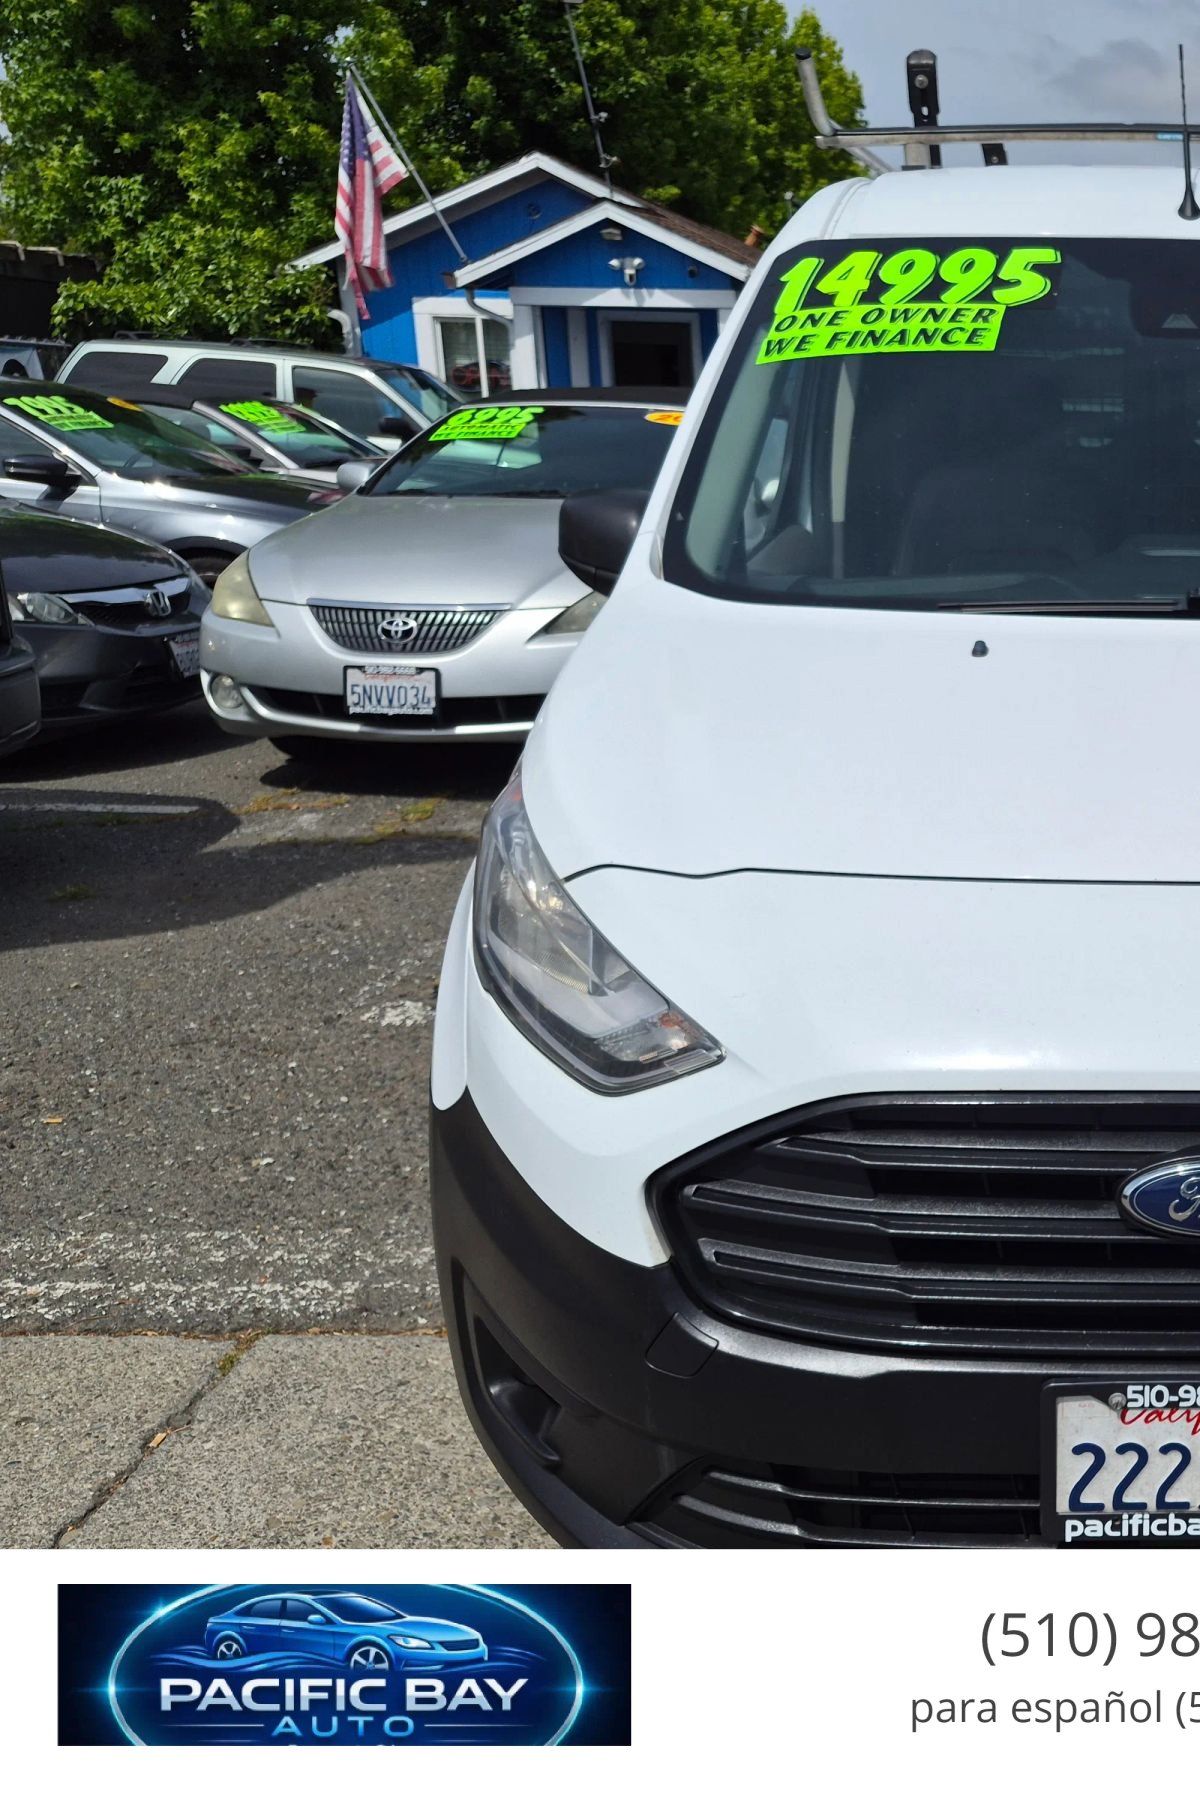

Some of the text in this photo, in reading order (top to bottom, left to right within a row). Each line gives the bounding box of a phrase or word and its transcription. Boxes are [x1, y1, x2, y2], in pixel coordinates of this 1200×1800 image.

[774, 248, 1062, 315] 14995
[774, 307, 998, 333] ONE OWNER
[764, 326, 991, 358] WE FINANCE
[447, 406, 545, 425] 6995
[350, 683, 431, 711] 5NVV034
